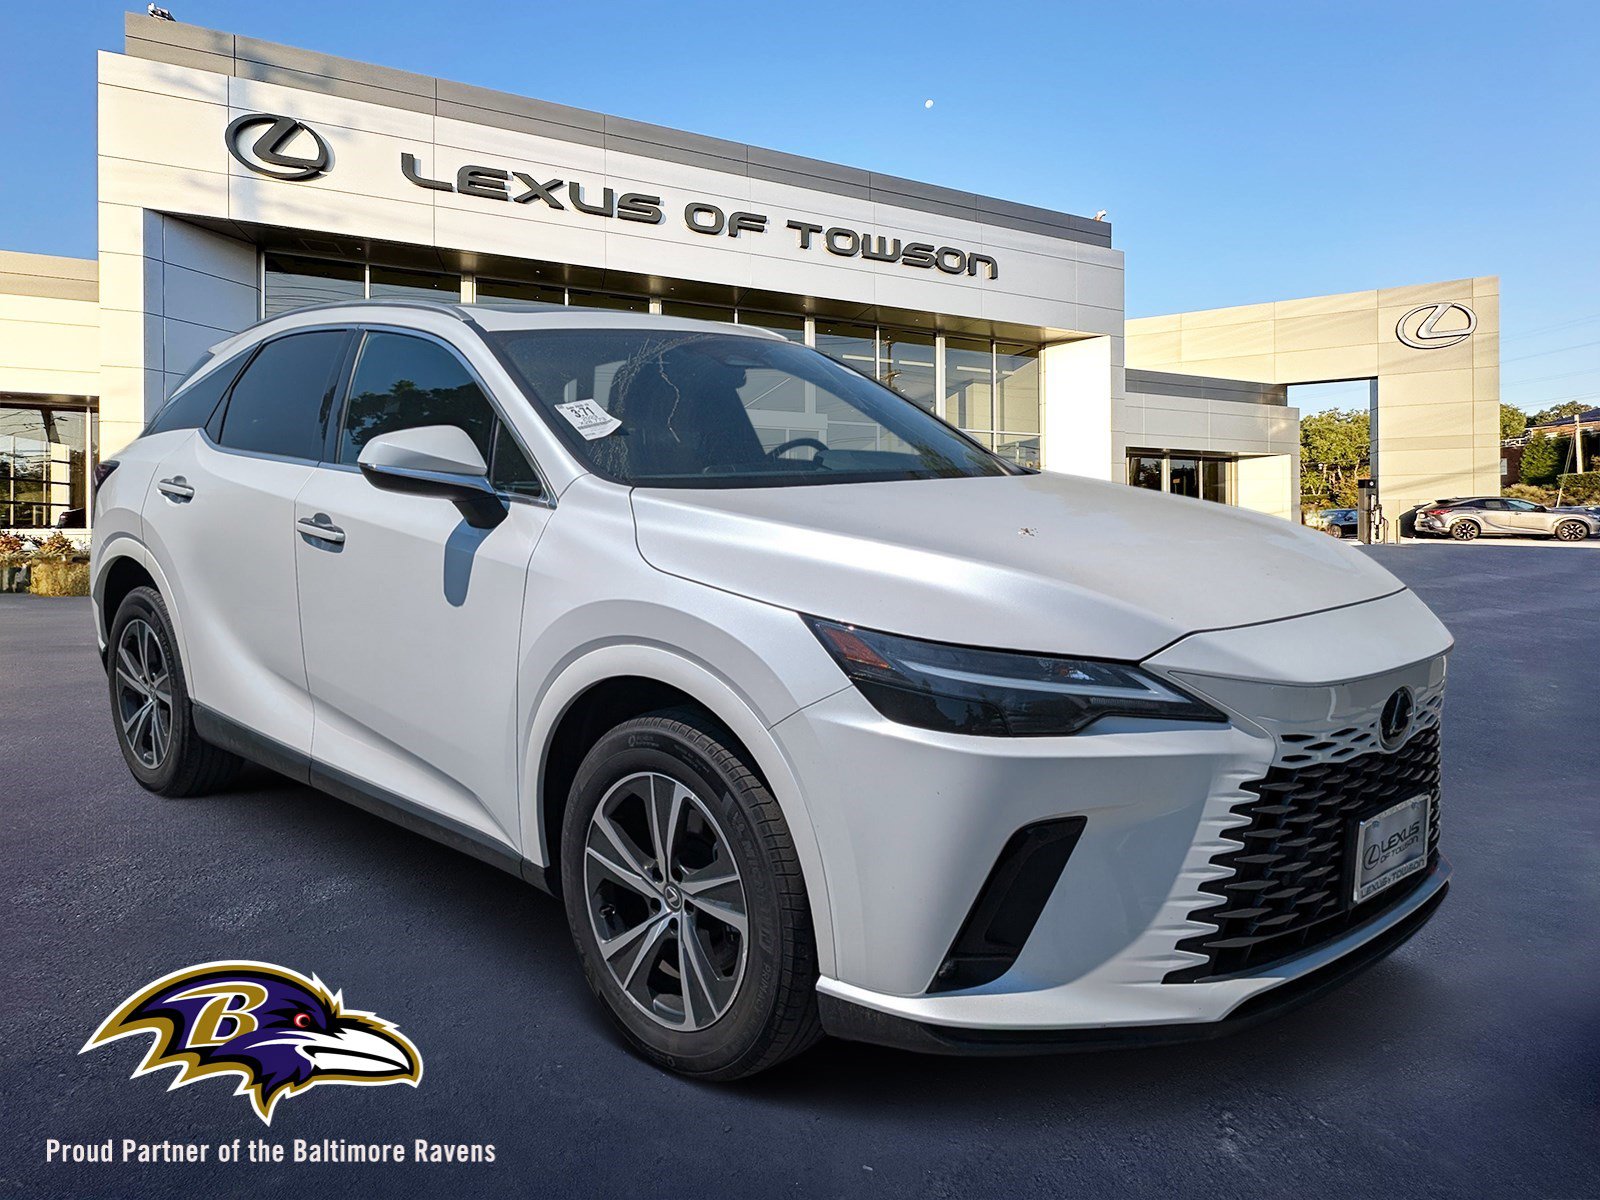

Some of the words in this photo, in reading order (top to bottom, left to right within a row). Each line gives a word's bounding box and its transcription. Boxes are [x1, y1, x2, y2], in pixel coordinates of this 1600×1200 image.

[401, 152, 664, 225] LEXUS
[684, 201, 767, 238] OF
[786, 218, 999, 280] TOWSON
[1381, 820, 1420, 853] LEXUS
[1380, 851, 1391, 864] OF
